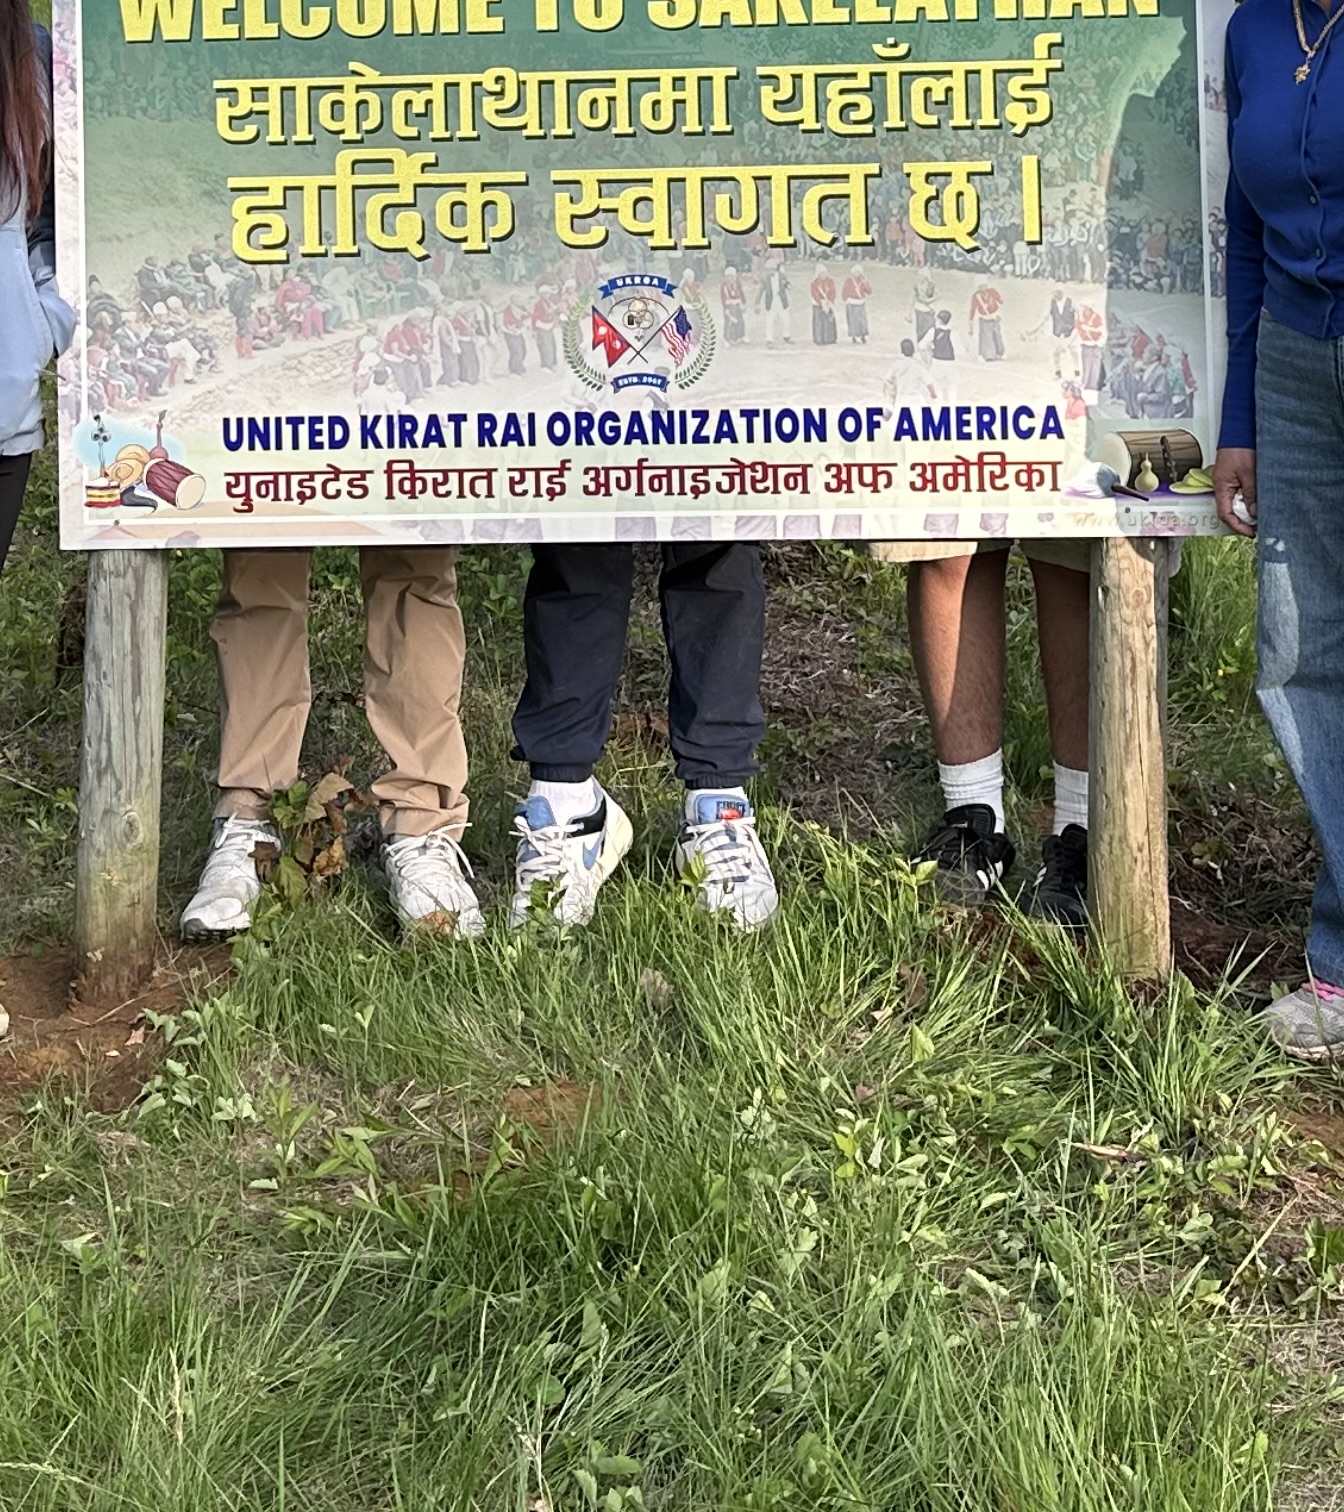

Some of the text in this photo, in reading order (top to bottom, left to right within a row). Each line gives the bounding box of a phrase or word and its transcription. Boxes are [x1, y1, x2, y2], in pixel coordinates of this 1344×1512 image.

[217, 63, 733, 141] साकेलाथानमा
[229, 148, 524, 261] हार्दिक
[552, 164, 877, 246] स्वागत
[223, 405, 1063, 451] UNITED KIRAT RAI ORGANIZATION OF AMERICA
[224, 450, 1062, 515] युनाइटेड किरात राई अर्गनाइजेशन अफ अमेरिका
